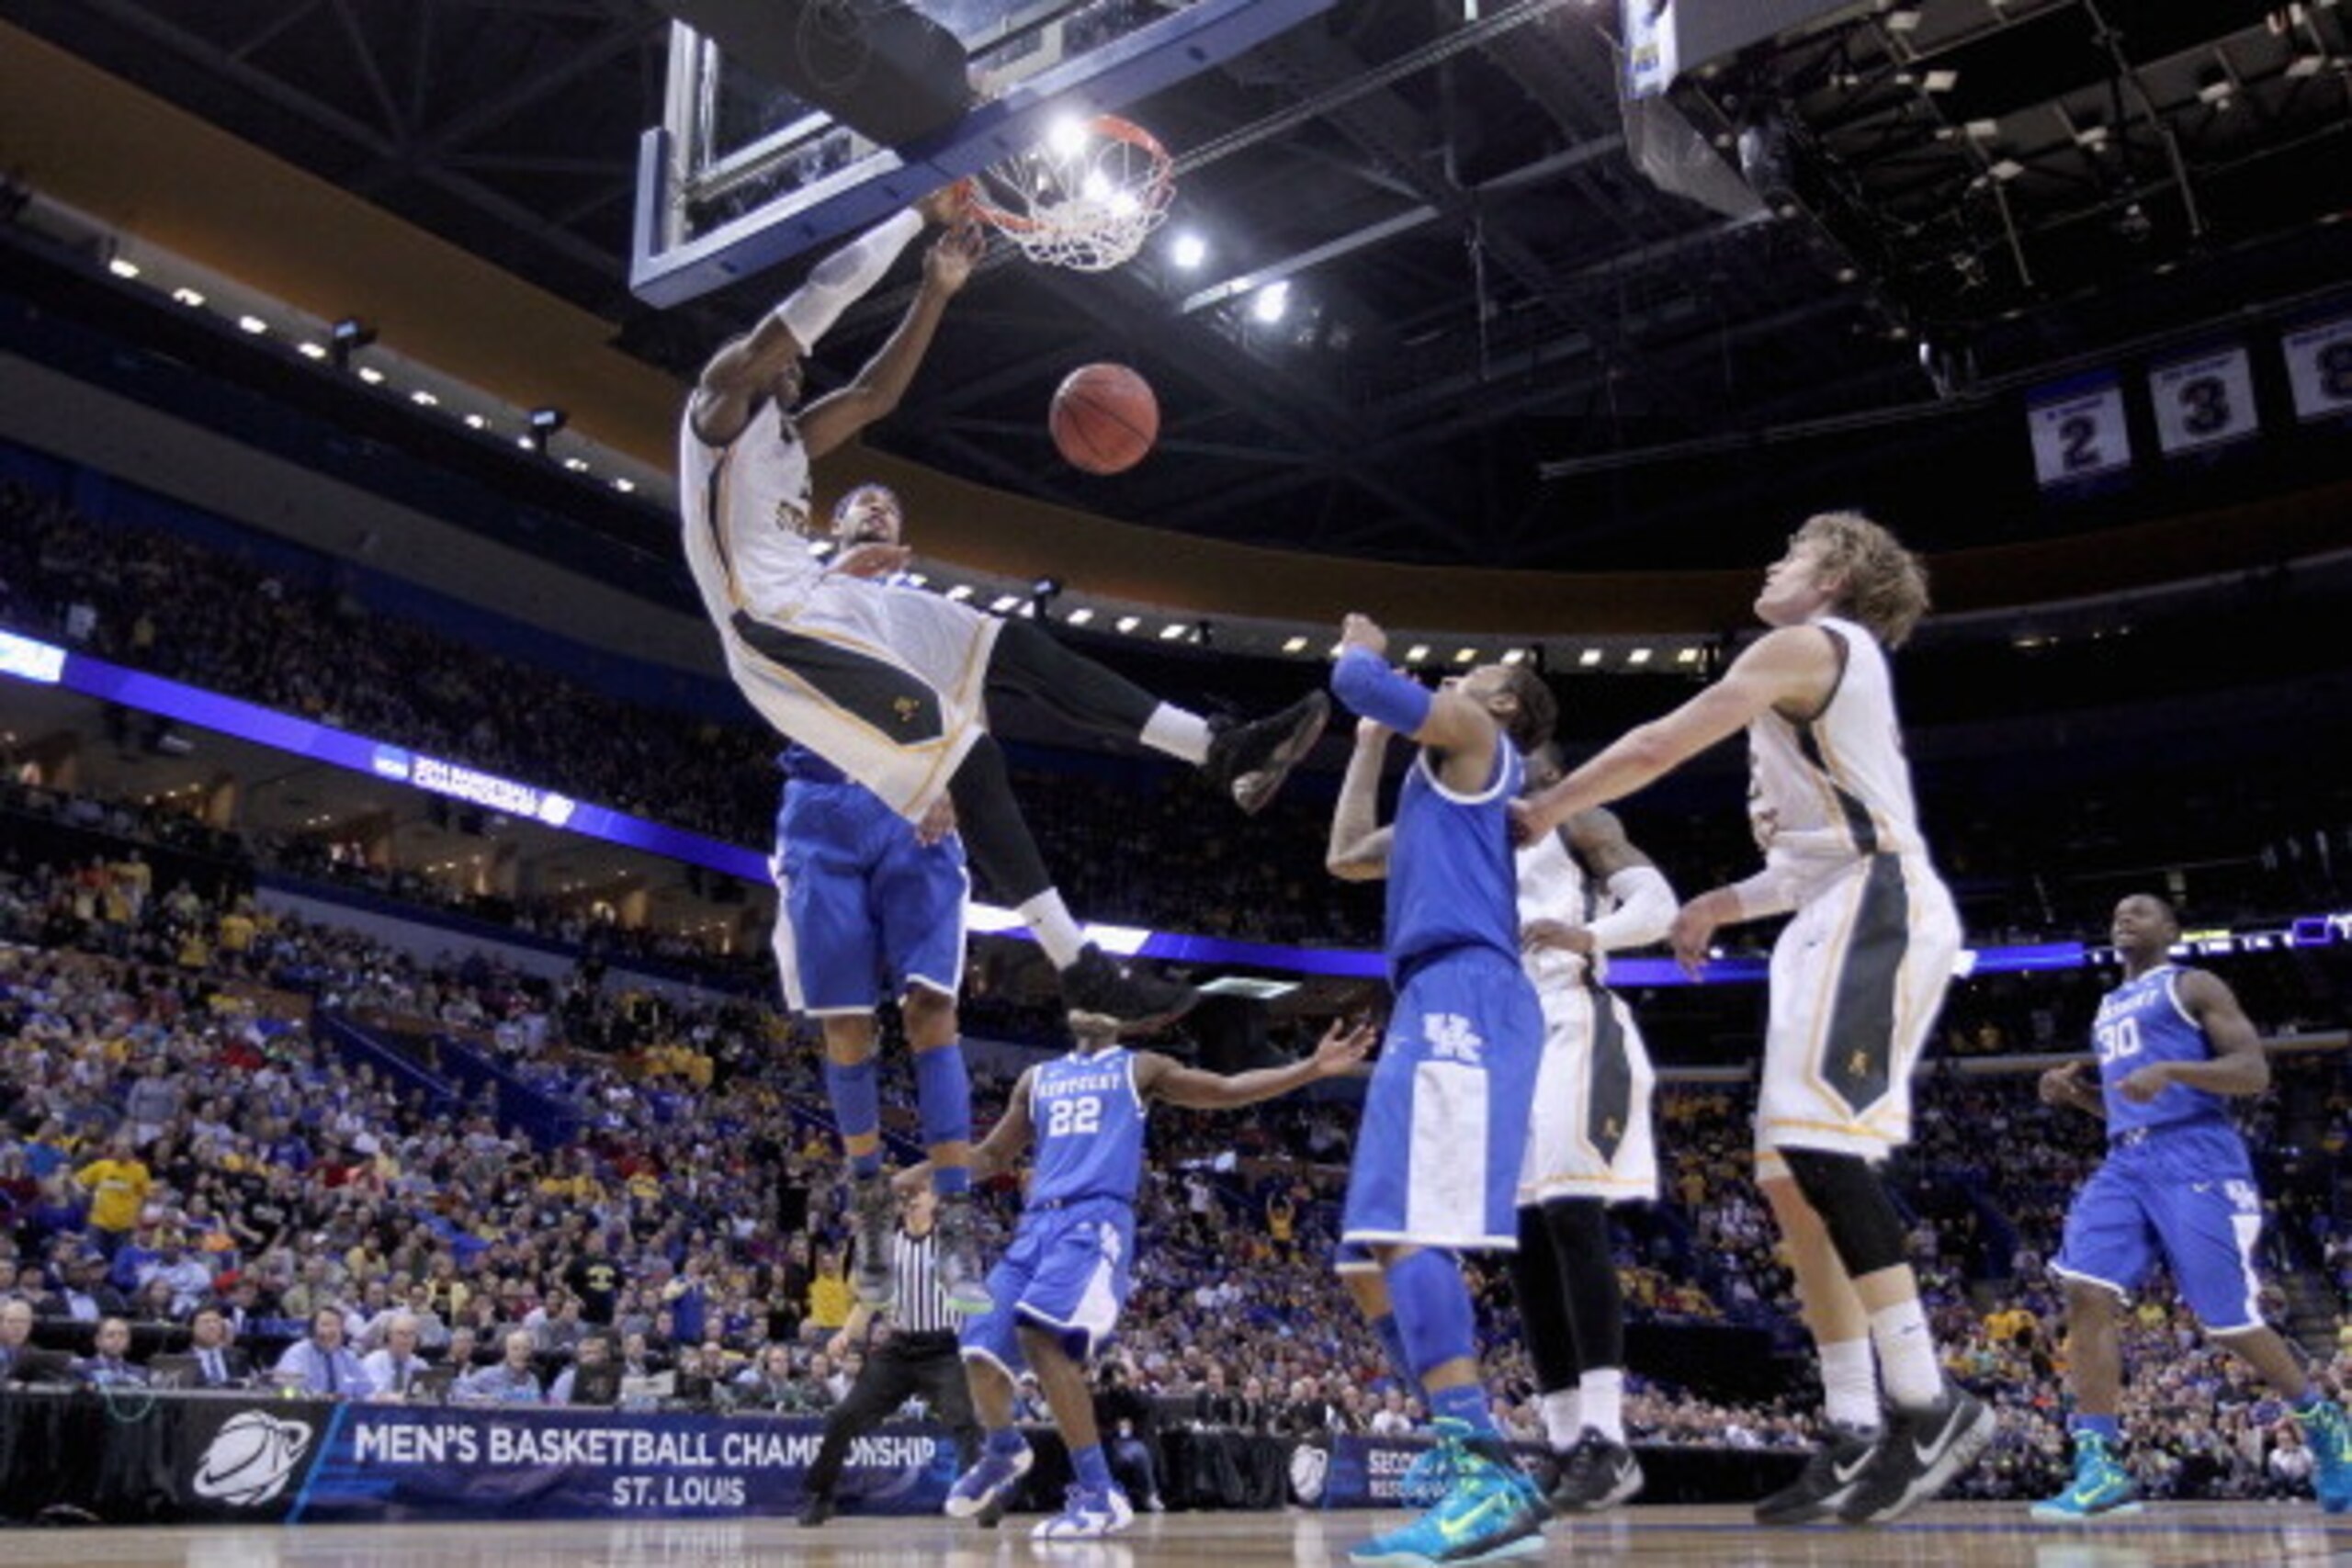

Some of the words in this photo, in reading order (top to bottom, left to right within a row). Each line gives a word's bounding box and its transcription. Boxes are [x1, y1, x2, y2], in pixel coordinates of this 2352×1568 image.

[2178, 376, 2232, 436] 3
[2059, 416, 2103, 469] 2
[1048, 1096, 1102, 1137] 22
[355, 1424, 479, 1462] MEN'S
[489, 1427, 715, 1467] BASKETBALL
[612, 1476, 657, 1506] ST.
[664, 1477, 745, 1506] LOUIS
